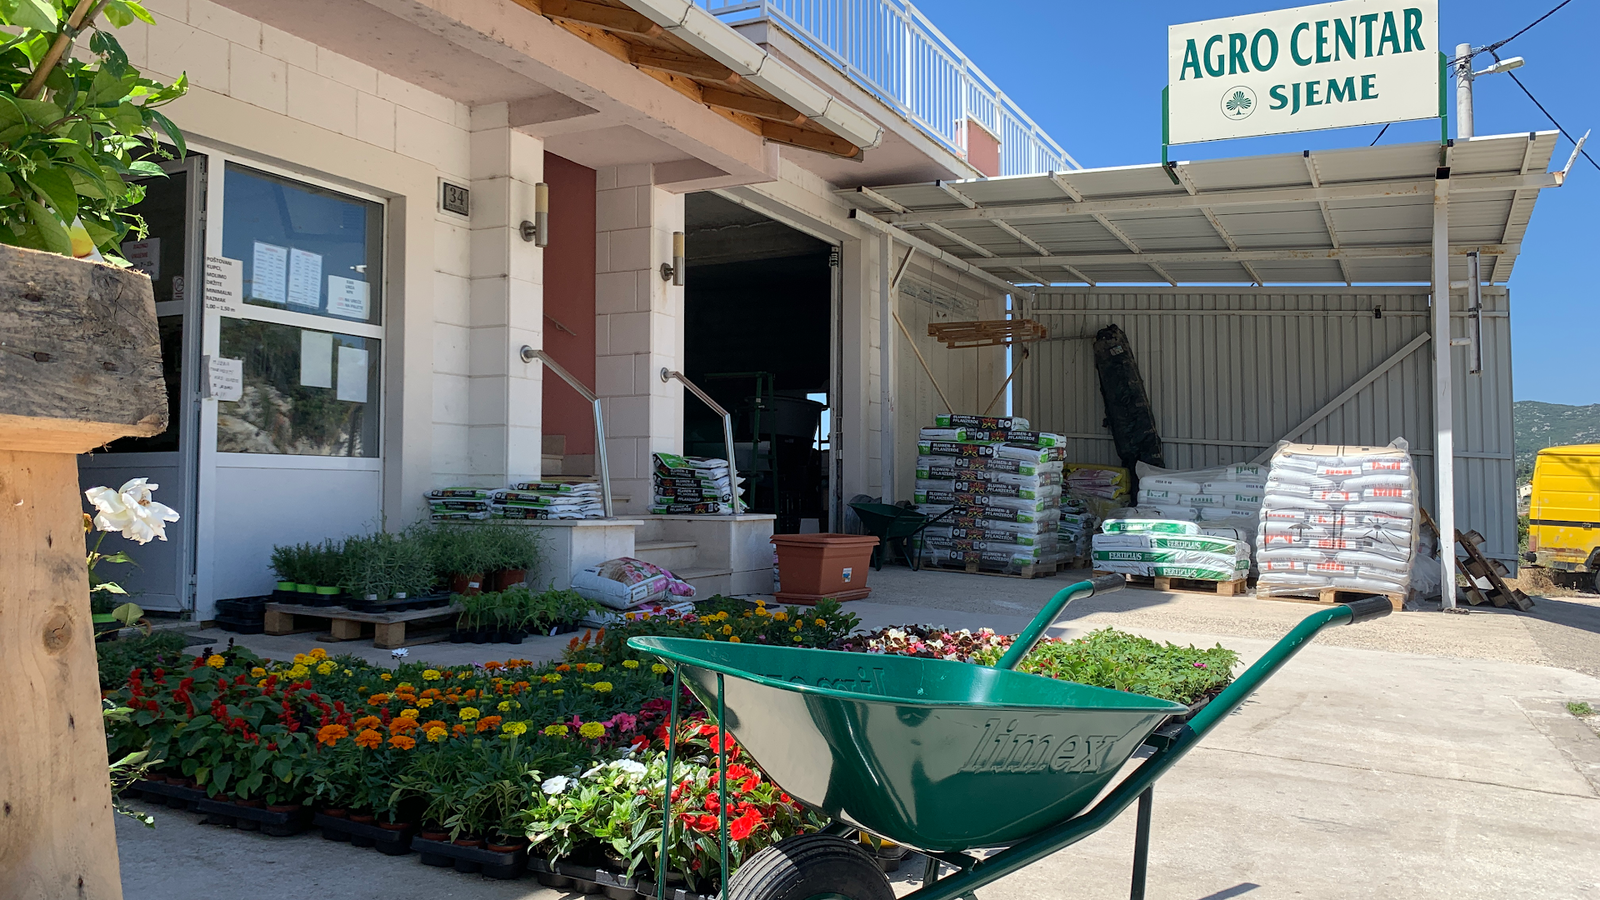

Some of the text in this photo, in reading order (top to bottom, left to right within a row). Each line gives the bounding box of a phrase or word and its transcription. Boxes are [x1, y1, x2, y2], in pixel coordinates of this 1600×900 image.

[1179, 7, 1426, 81] AGRO CENTAR
[1269, 73, 1379, 116] SJEME
[449, 187, 465, 206] 34
[206, 256, 232, 266] POŠTOVANI
[206, 288, 232, 296] MINIMALNI
[1167, 540, 1201, 549] FERTIPLUS
[1109, 552, 1142, 560] FERTIPLUS
[1163, 567, 1197, 576] FERTIPLUS
[957, 718, 1118, 775] limex
